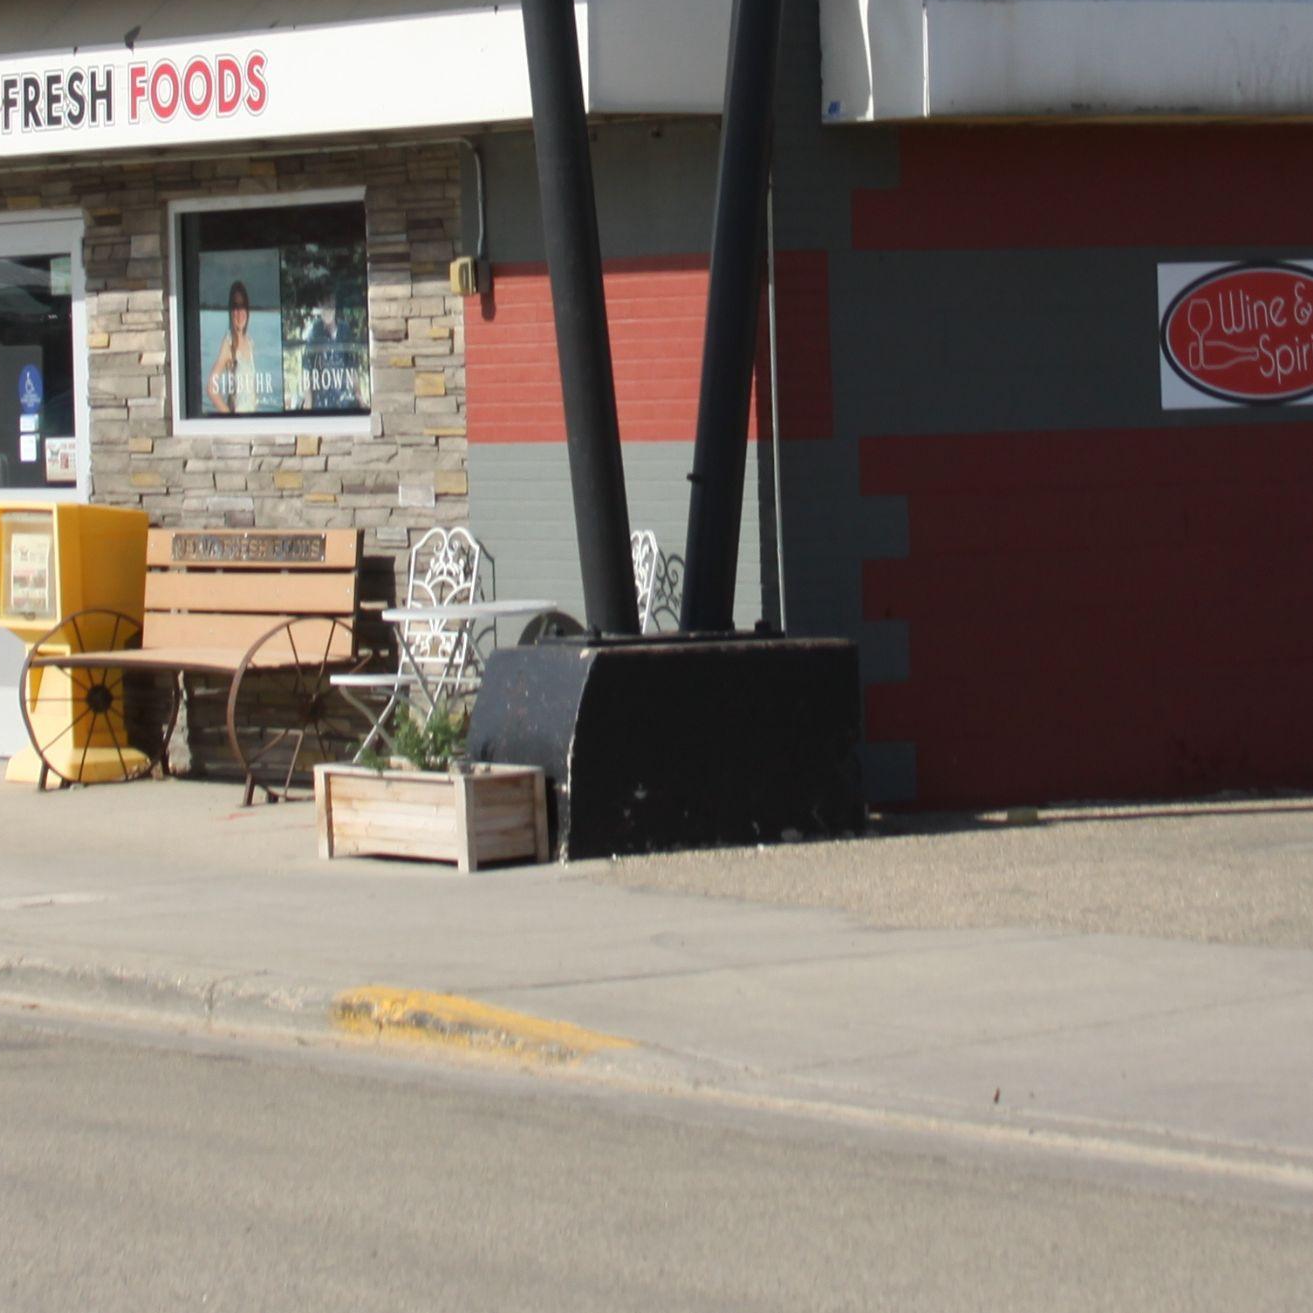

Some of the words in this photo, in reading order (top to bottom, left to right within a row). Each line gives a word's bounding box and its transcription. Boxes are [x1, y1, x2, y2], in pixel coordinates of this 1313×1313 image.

[2, 65, 116, 135] FRESH
[128, 49, 270, 125] FOODS
[1218, 289, 1287, 334] Wine
[1293, 281, 1313, 325] &
[303, 367, 355, 391] BROWN
[1259, 333, 1313, 385] Spir
